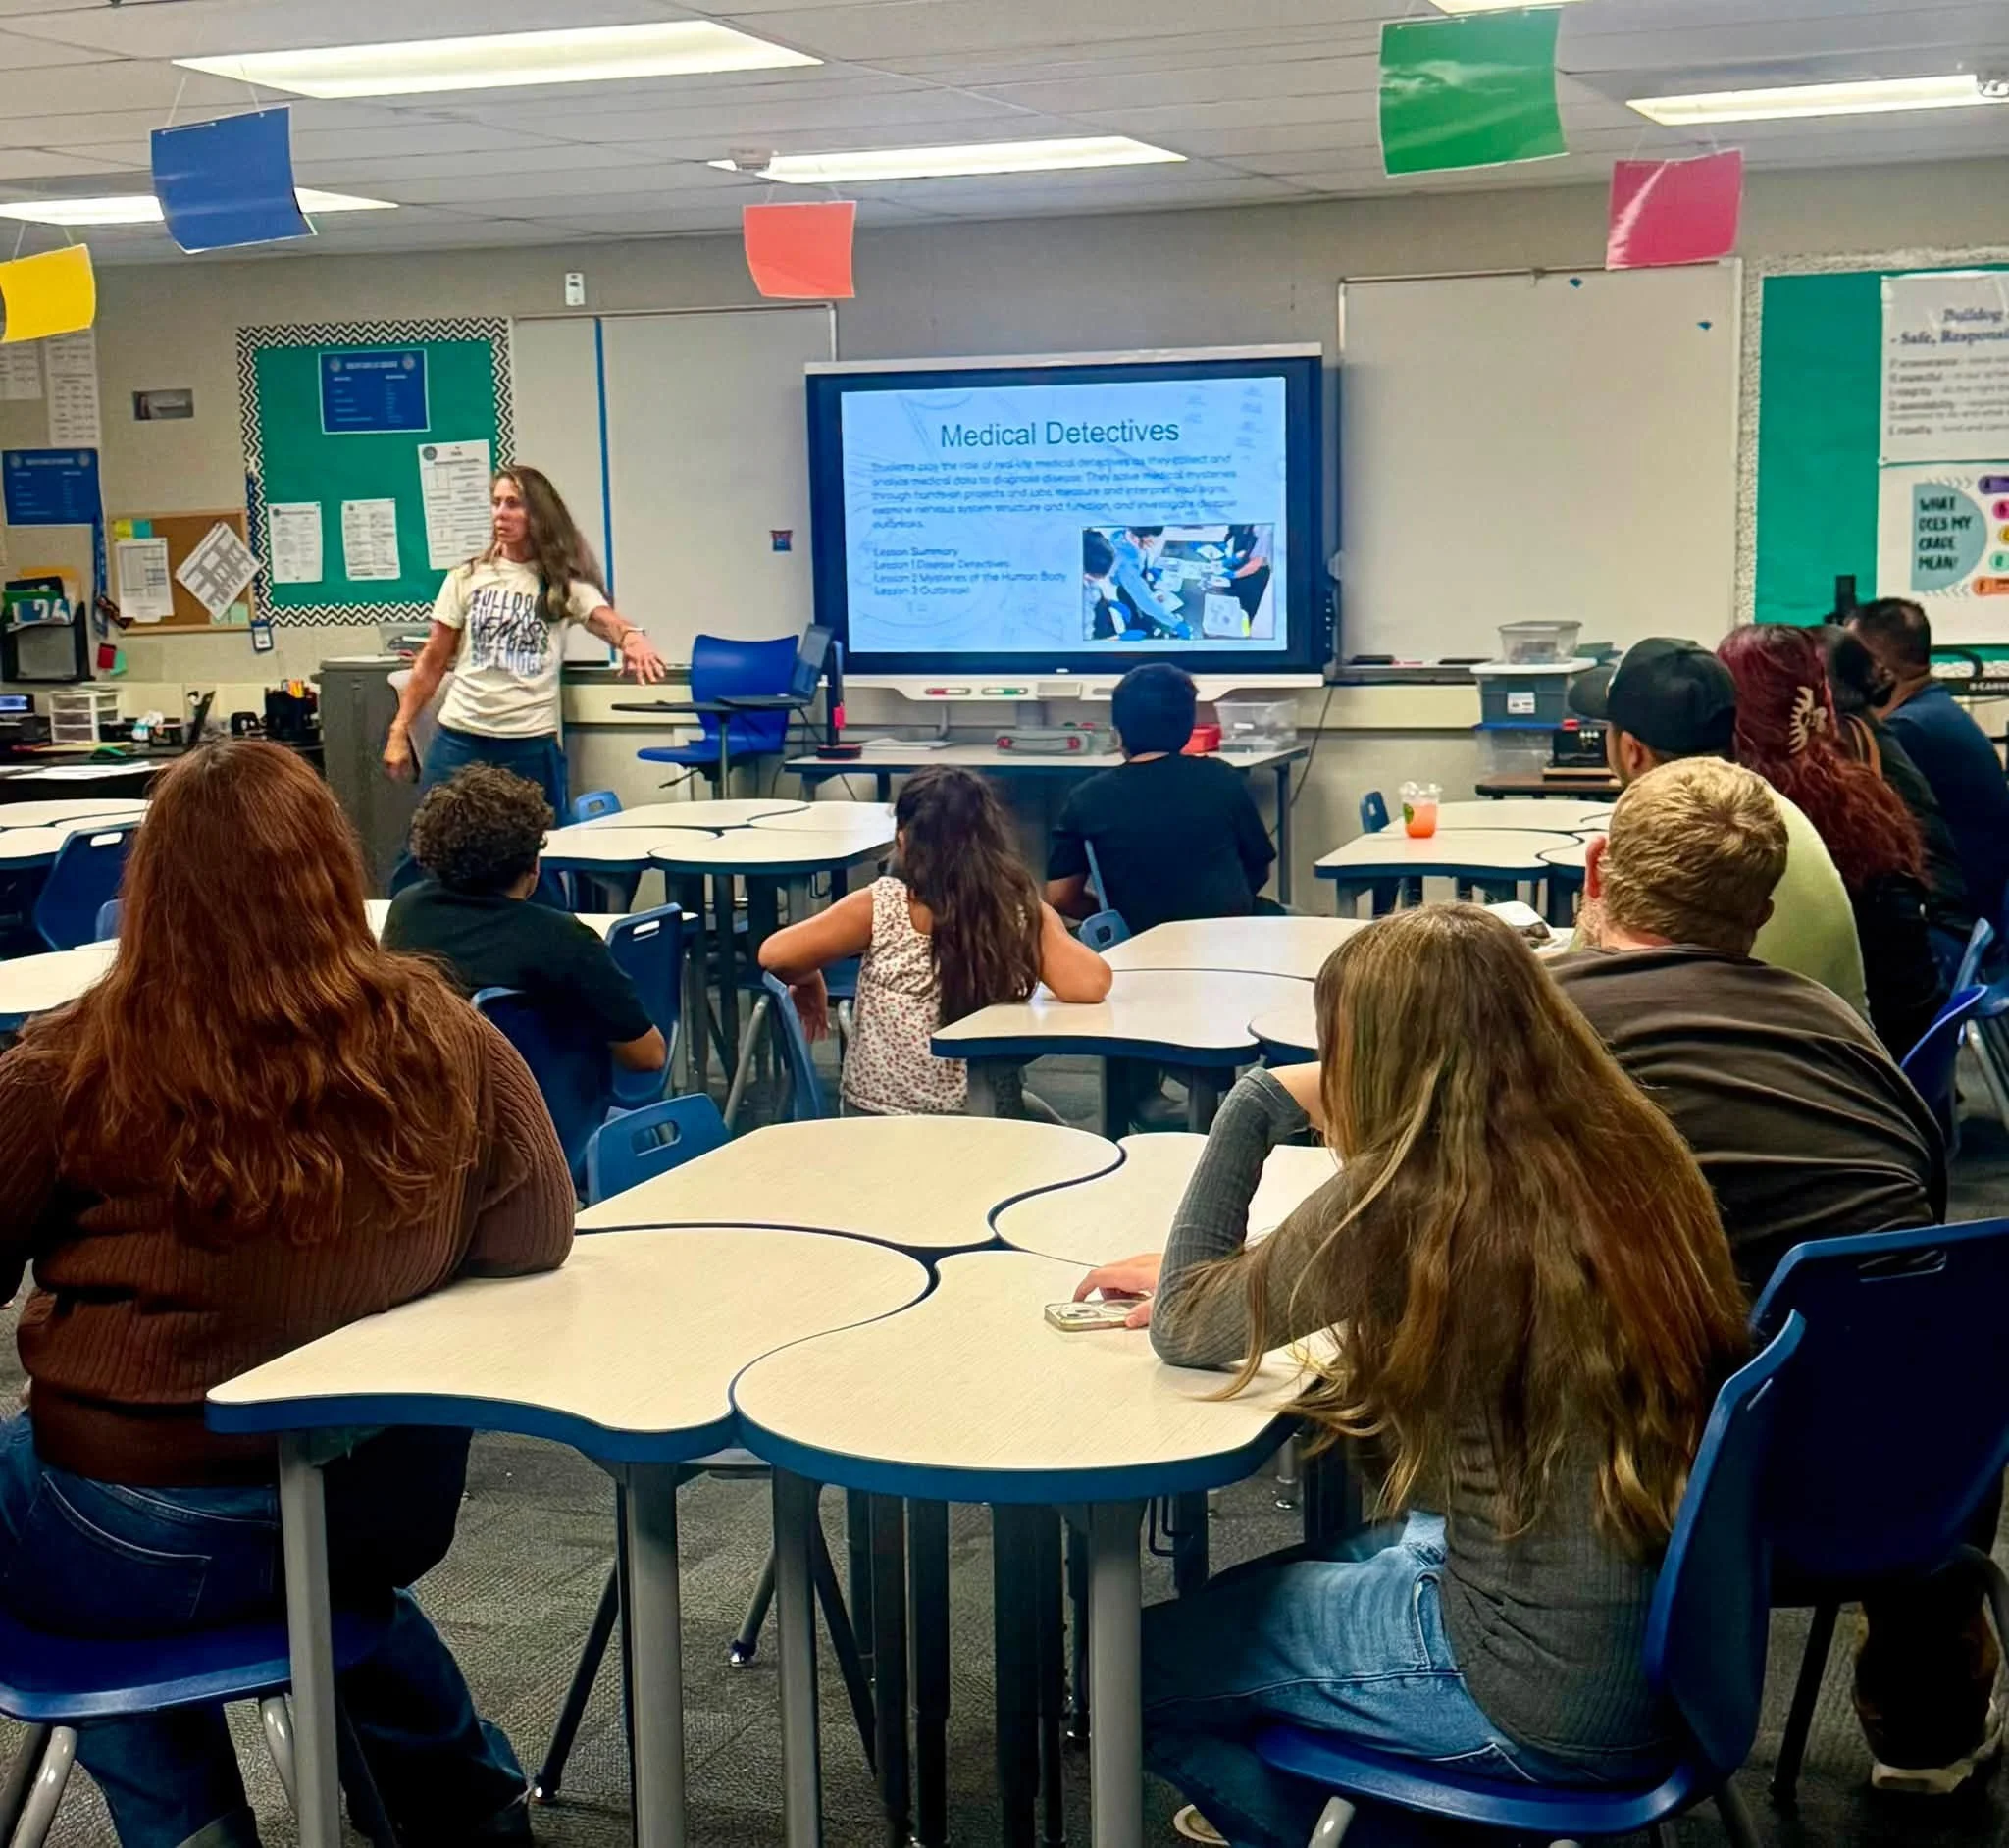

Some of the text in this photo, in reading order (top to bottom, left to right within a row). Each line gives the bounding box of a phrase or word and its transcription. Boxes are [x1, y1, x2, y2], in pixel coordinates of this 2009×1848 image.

[941, 418, 1180, 448] Medical Detectives
[941, 461, 957, 471] the
[959, 461, 979, 471] role
[982, 460, 992, 470] of
[1210, 454, 1232, 464] and
[1086, 471, 1110, 483] They
[1918, 496, 1957, 512] WHAT
[1918, 516, 1972, 532] DOES MY
[1918, 537, 1957, 551] GRADE
[873, 546, 959, 558] Lesson Summary
[874, 561, 910, 570] Lesson
[874, 573, 910, 583] Lesson
[969, 572, 981, 582] of
[982, 572, 999, 582] the
[1001, 571, 1038, 582] Human
[1040, 570, 1068, 583] Body
[874, 586, 910, 595] Lesson
